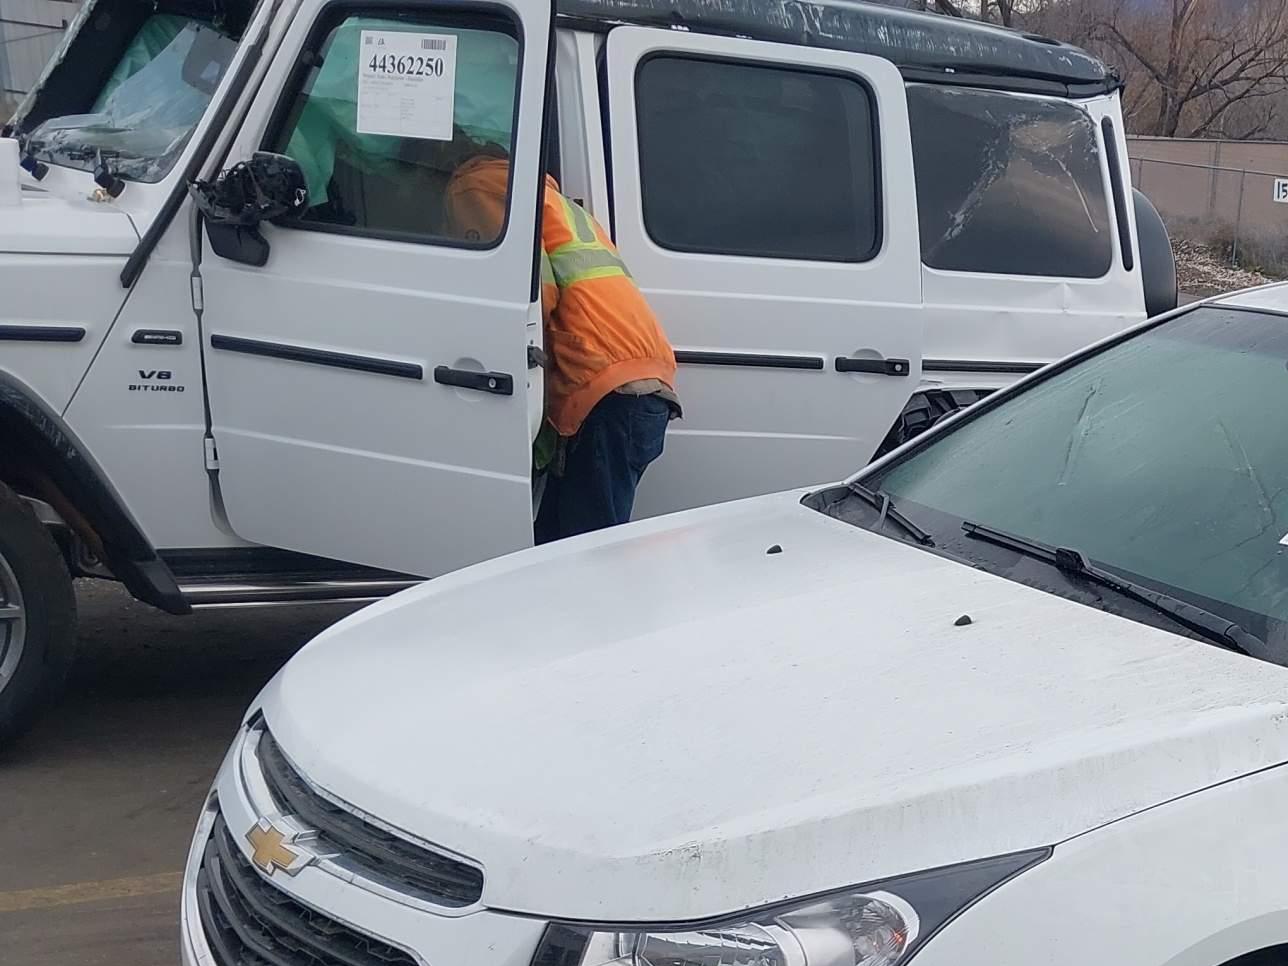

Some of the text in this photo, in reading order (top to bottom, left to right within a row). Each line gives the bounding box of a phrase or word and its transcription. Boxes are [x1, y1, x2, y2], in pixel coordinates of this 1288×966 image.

[369, 53, 444, 77] 44362250
[1277, 181, 1288, 200] 15
[138, 369, 171, 380] V8
[128, 384, 185, 392] BITURBO
